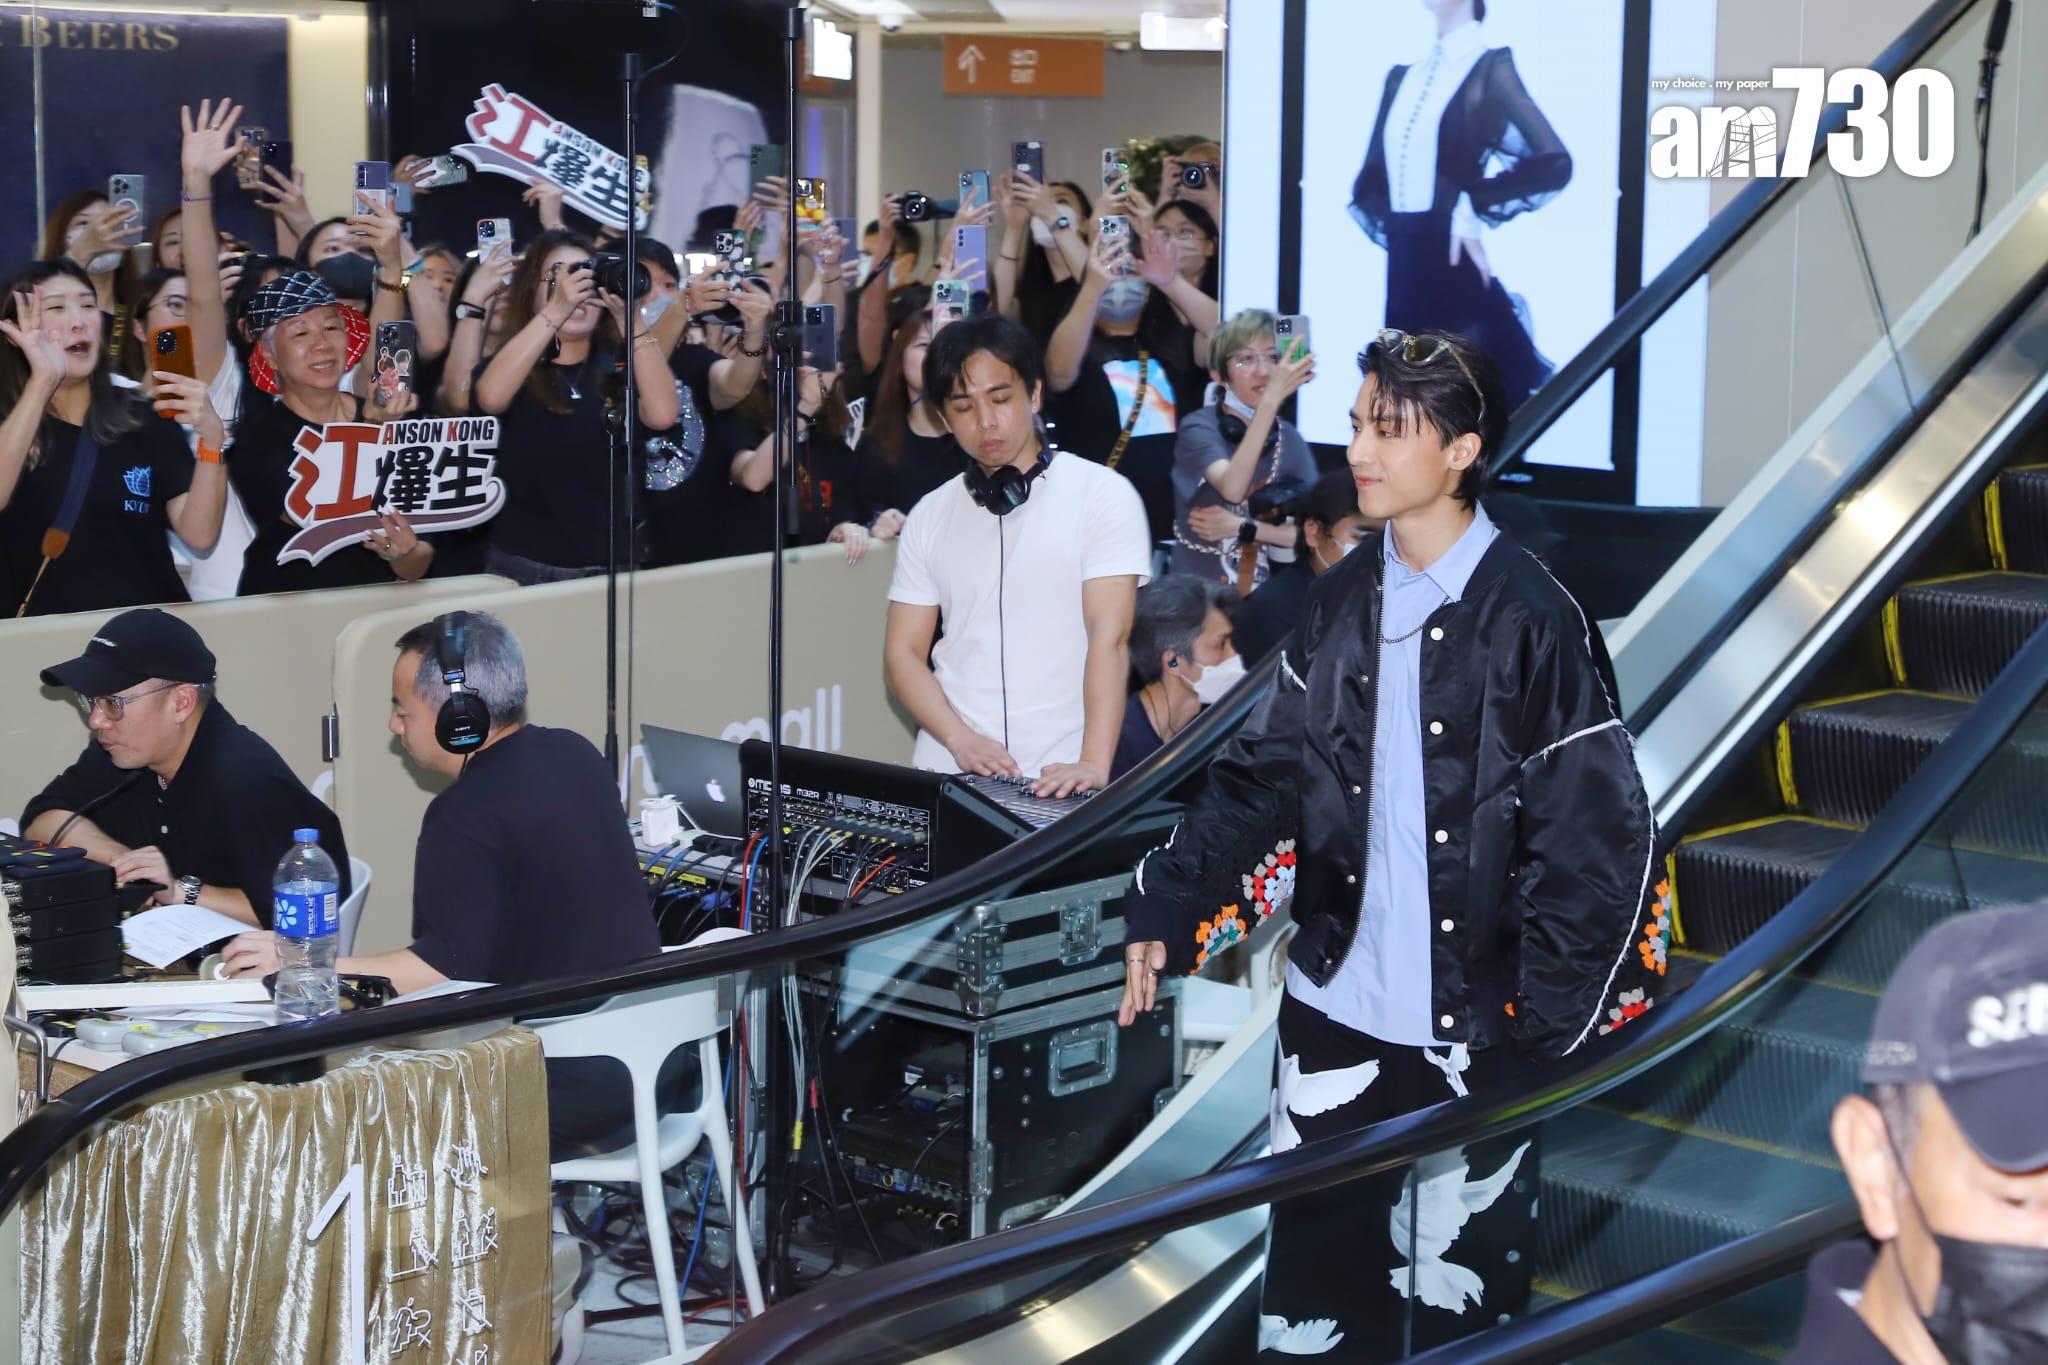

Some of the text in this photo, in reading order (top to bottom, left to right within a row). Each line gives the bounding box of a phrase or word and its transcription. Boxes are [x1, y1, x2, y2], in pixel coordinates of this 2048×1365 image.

[17, 14, 180, 51] BEERS
[553, 121, 603, 158] ANSON
[382, 419, 495, 445] ANSON KONG
[755, 778, 792, 795] MIDS
